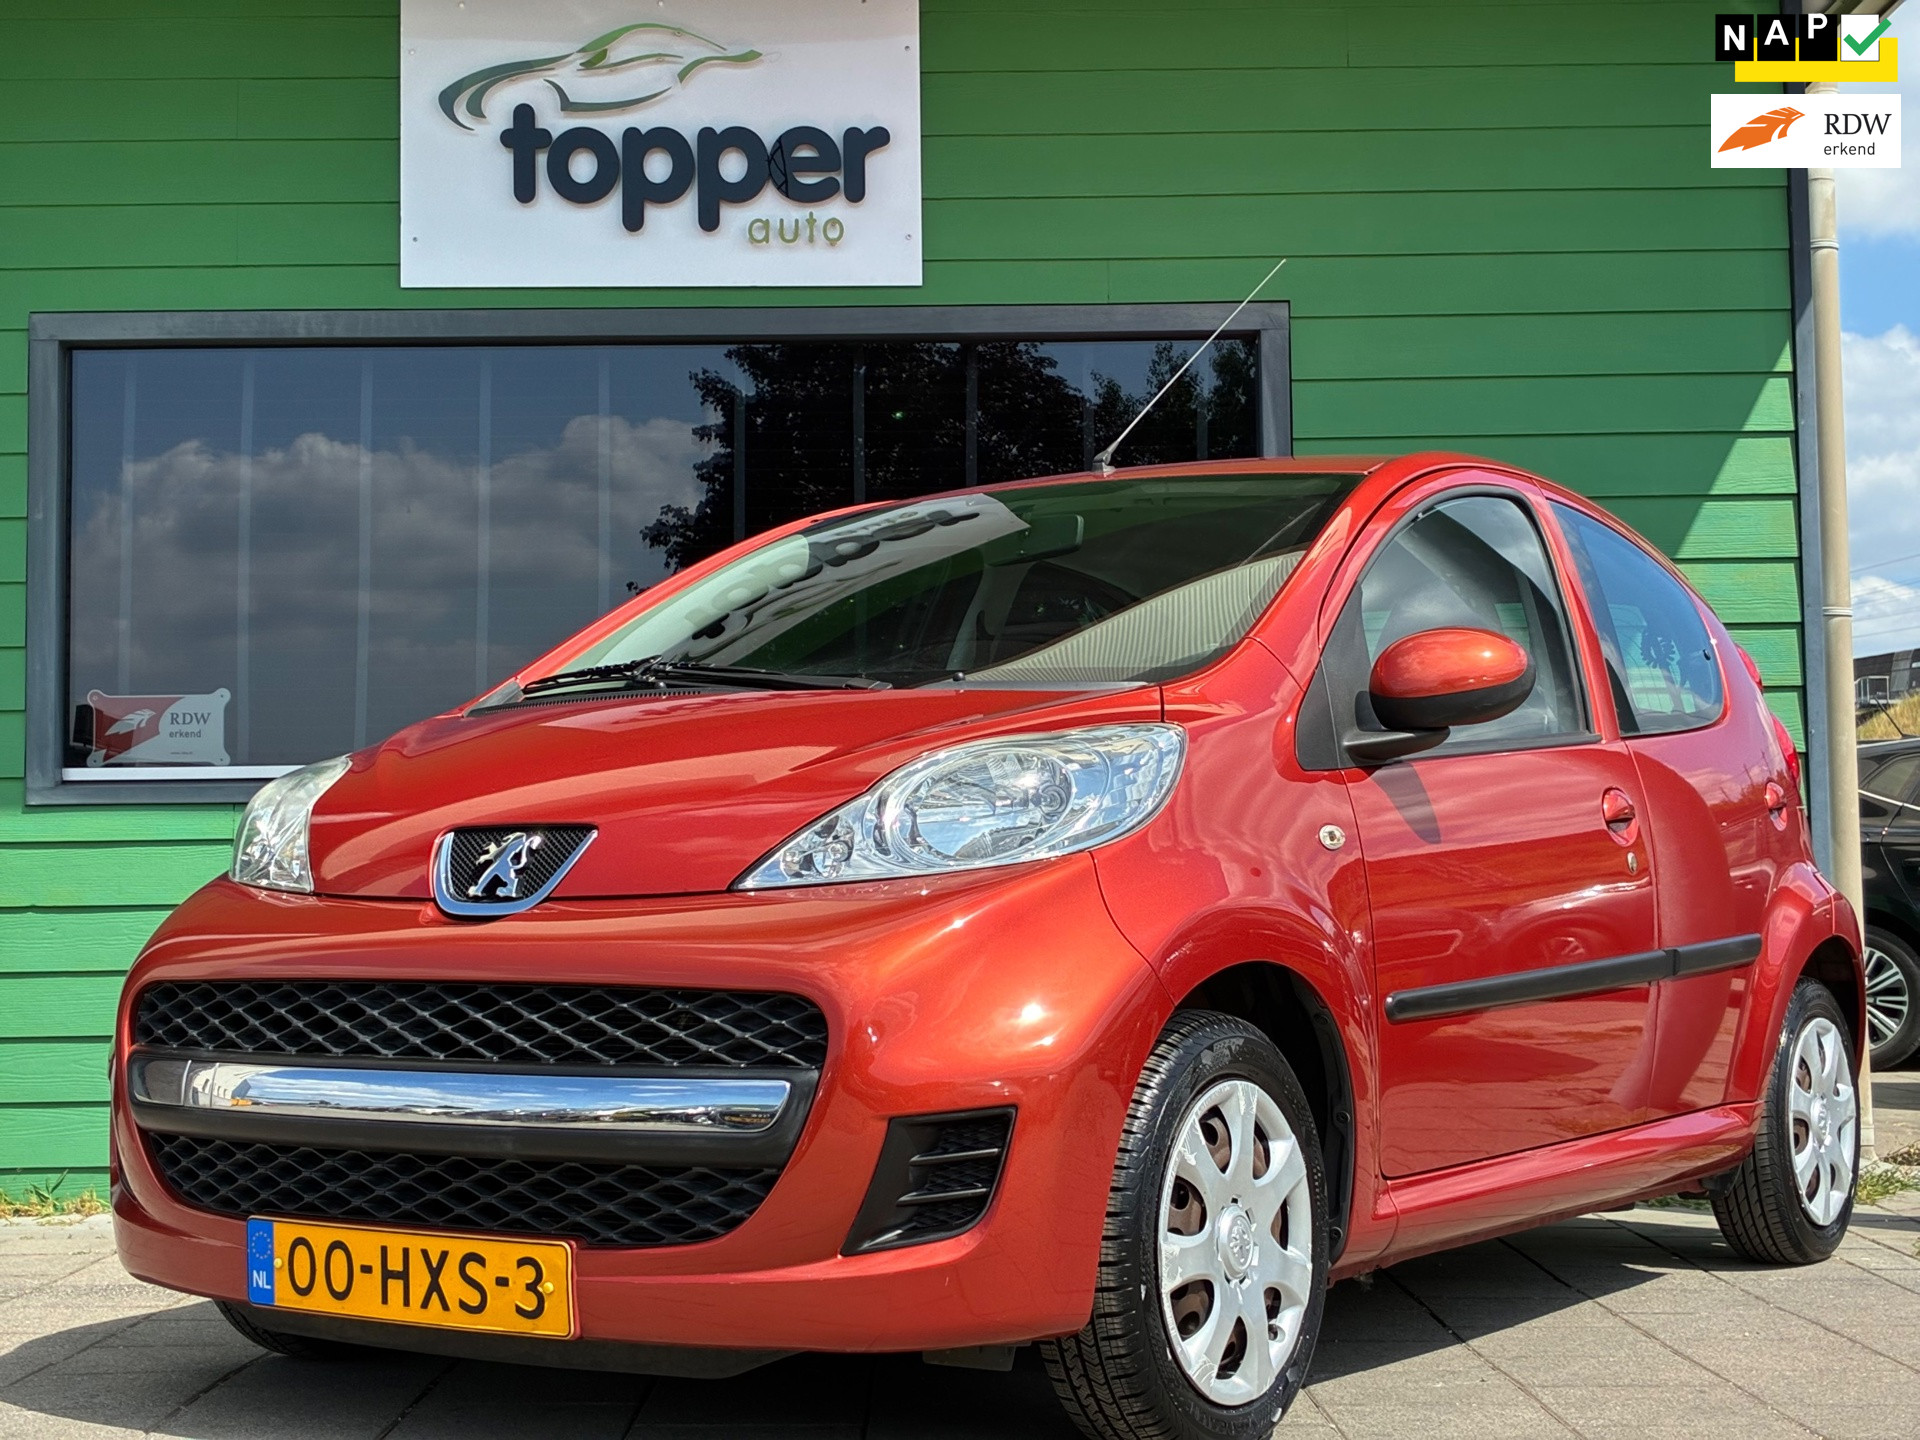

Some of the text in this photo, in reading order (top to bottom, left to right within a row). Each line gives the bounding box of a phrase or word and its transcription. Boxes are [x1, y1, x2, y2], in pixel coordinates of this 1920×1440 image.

[500, 102, 890, 232] topper
[747, 211, 845, 247] auto
[170, 712, 211, 725] RDW
[168, 729, 202, 738] erkend
[252, 1269, 271, 1290] NL
[287, 1236, 547, 1320] 00-HXS-3
